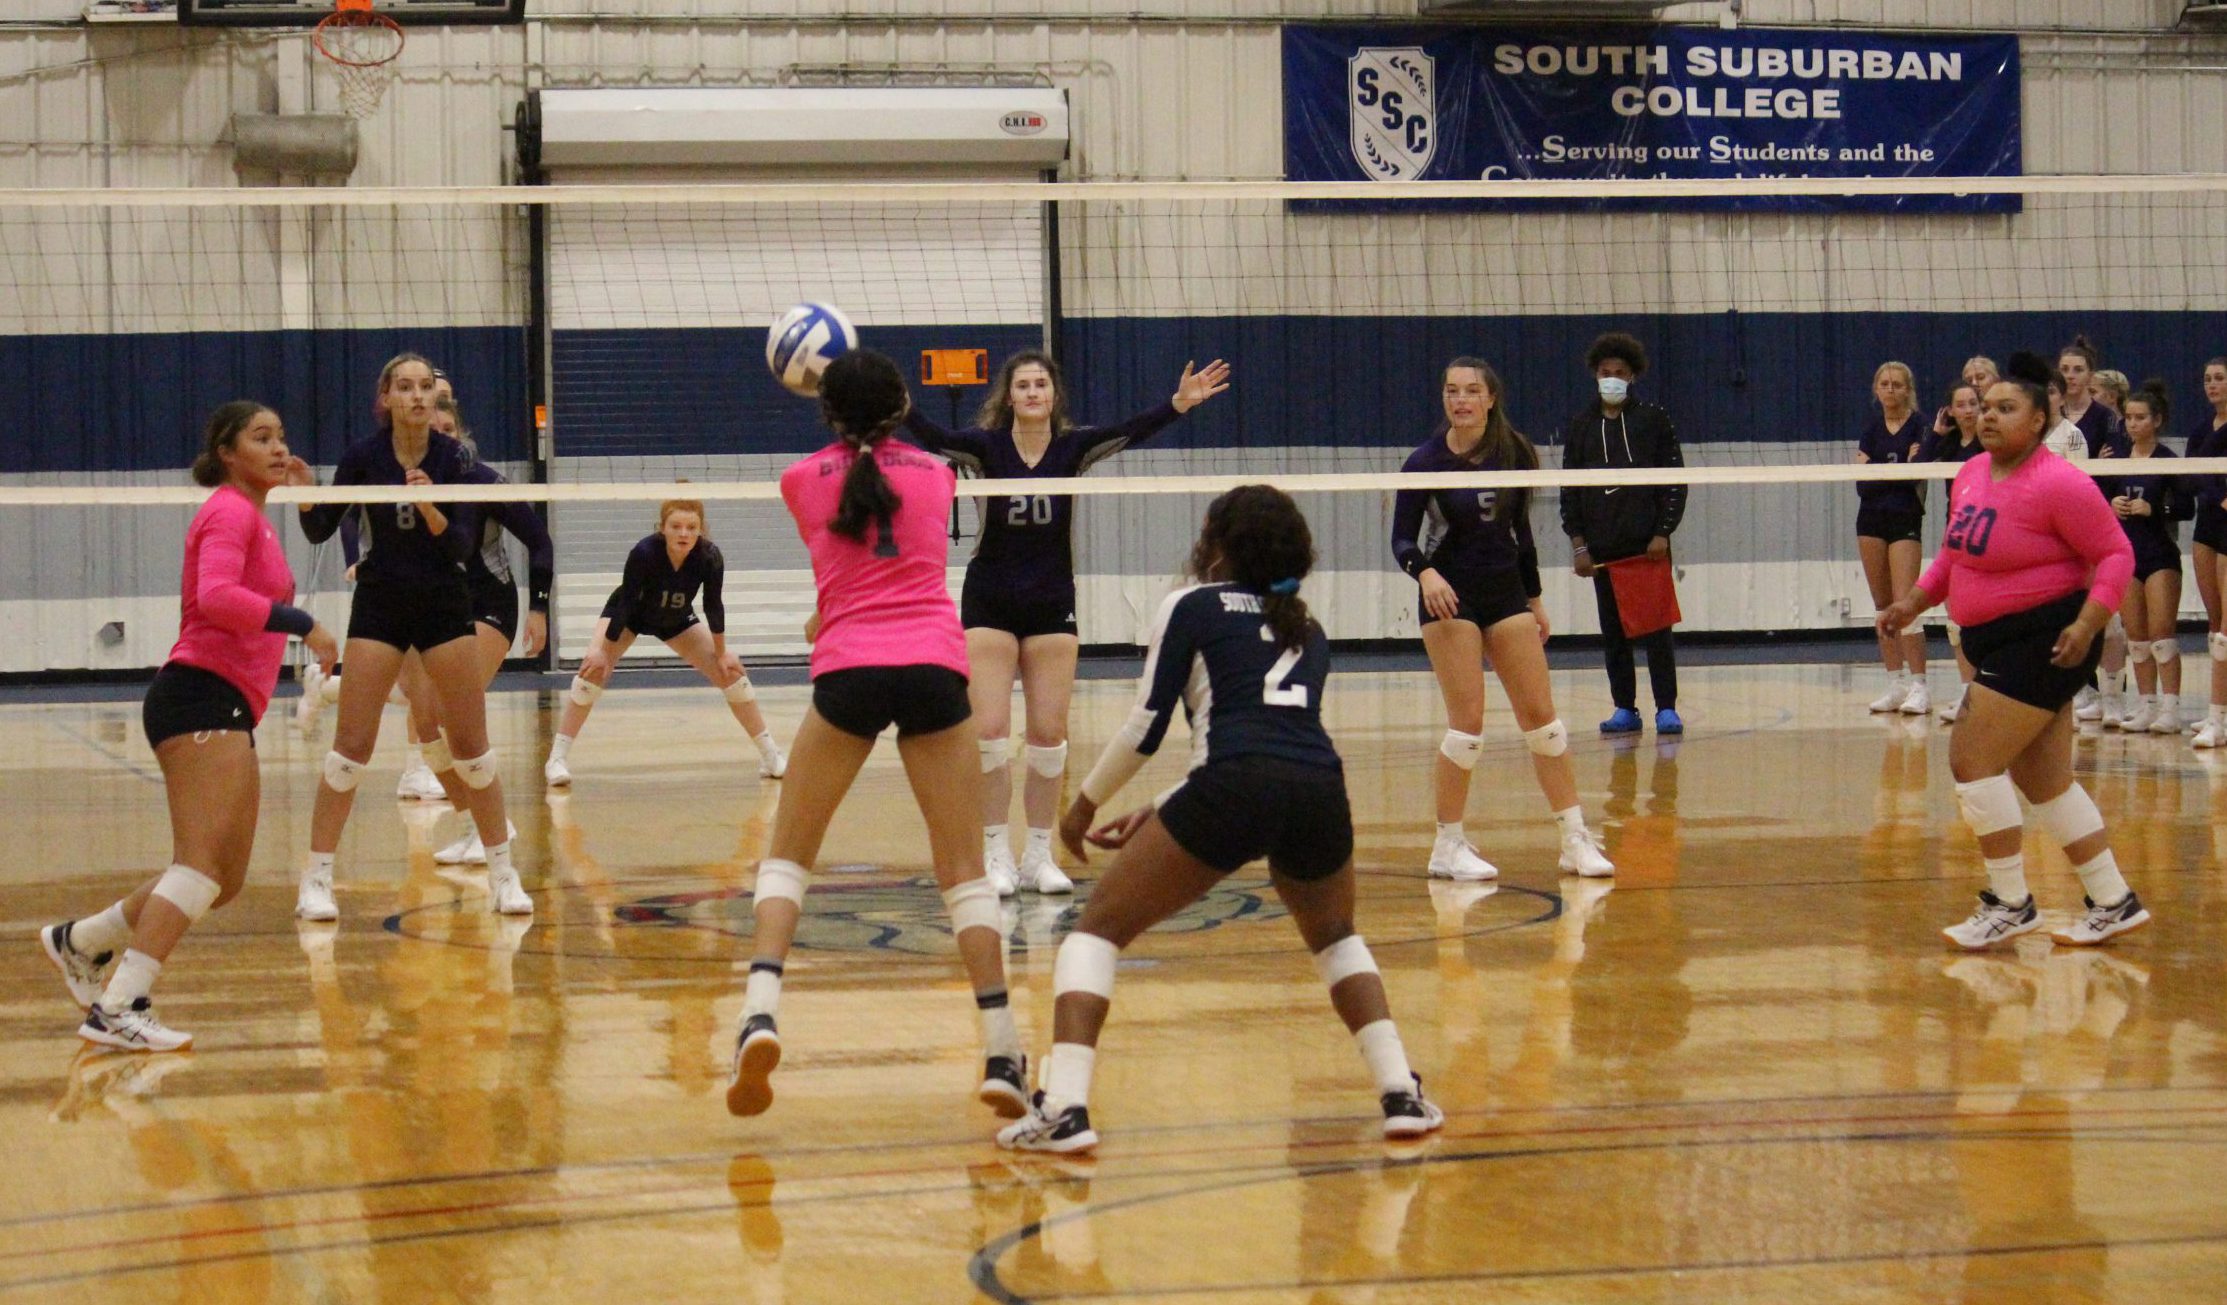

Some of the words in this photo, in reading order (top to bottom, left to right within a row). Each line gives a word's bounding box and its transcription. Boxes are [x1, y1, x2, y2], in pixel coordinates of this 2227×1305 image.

[1495, 45, 1668, 75] SOUTH
[1687, 46, 1962, 81] SUBURBAN
[1357, 67, 1428, 154] SSC
[1611, 85, 1841, 119] COLLEGE
[1656, 146, 1701, 160] our
[1709, 135, 1830, 164] Students
[1839, 142, 1885, 161] and
[1893, 143, 1935, 162] the
[396, 501, 416, 530] 8
[1008, 495, 1053, 525] 20
[1477, 491, 1496, 521] 5
[1947, 504, 1998, 556] 20
[660, 590, 686, 608] 19
[1259, 622, 1308, 708] 2
